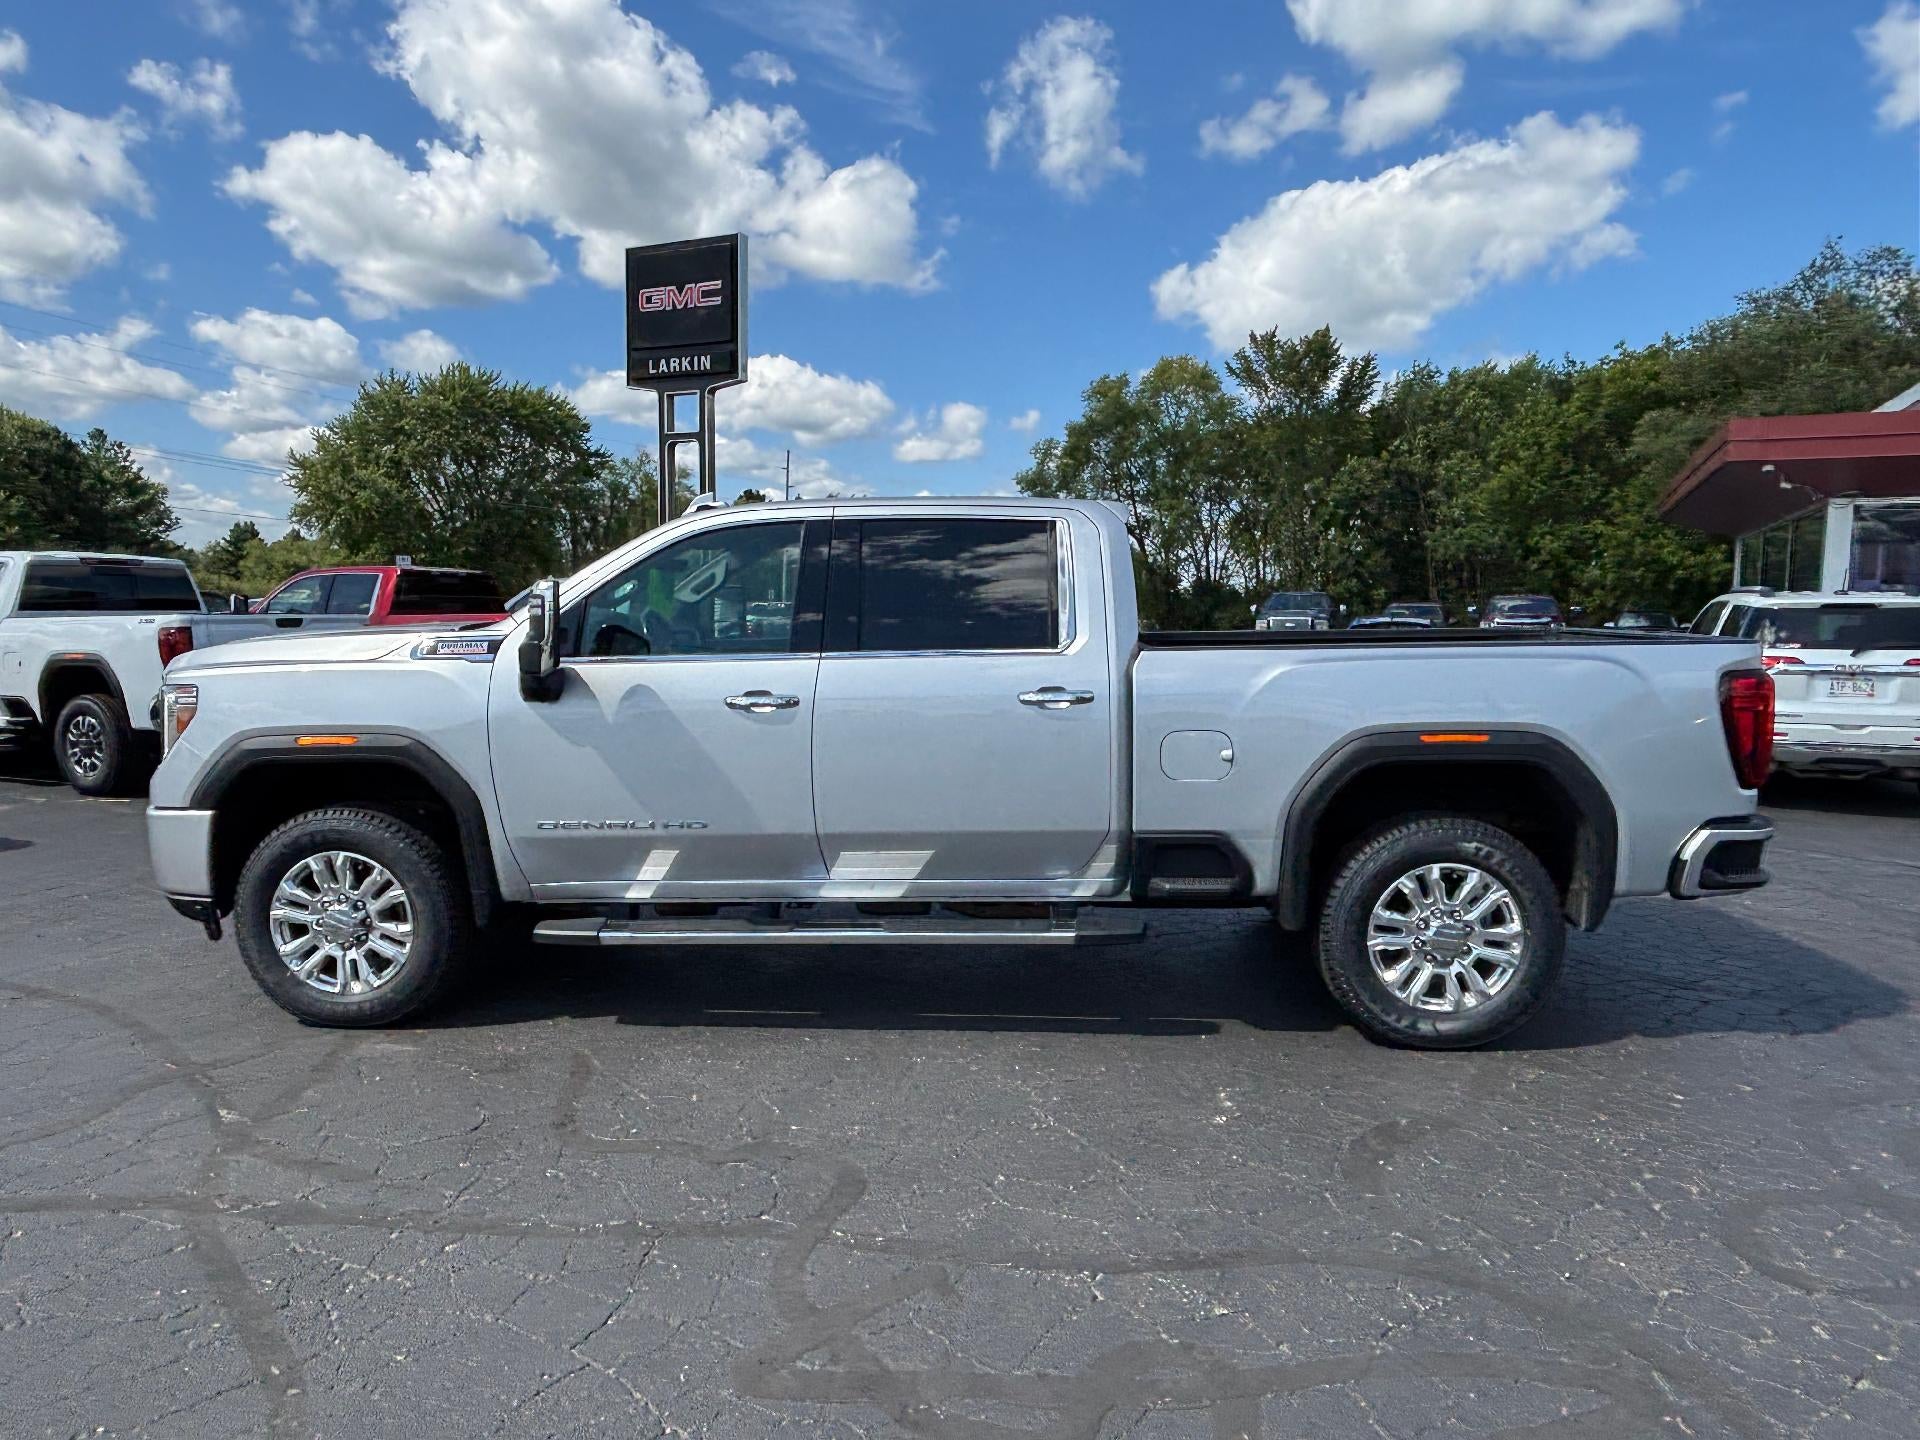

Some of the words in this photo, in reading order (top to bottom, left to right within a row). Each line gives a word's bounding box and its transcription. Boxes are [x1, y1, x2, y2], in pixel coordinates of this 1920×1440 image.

[639, 280, 722, 312] GMC
[648, 355, 711, 374] LARKIN
[440, 642, 485, 650] DURAMAX
[537, 820, 656, 830] DENALI
[663, 820, 708, 830] HD
